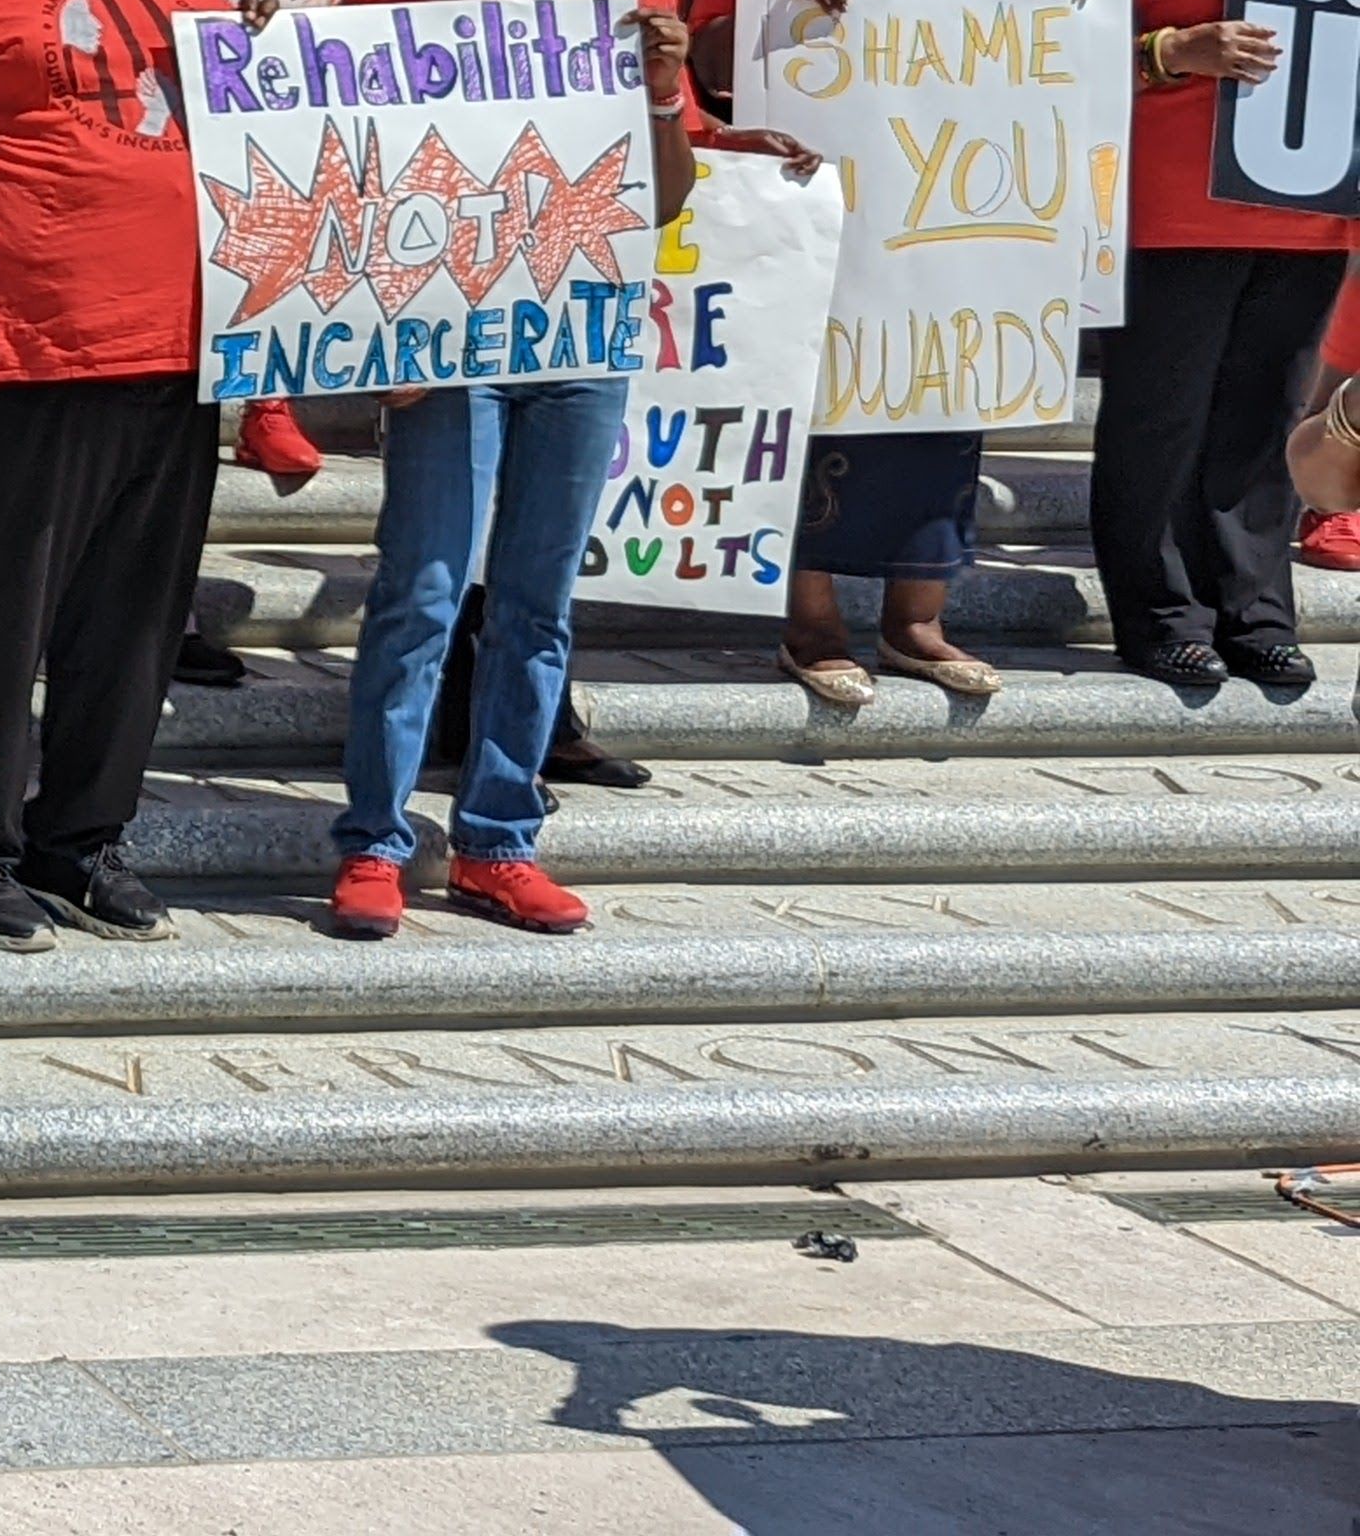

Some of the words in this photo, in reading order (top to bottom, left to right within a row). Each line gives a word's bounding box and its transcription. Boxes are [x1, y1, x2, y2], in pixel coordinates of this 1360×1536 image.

[782, 0, 1075, 100] SHAME
[887, 104, 1068, 230] YOU
[211, 279, 646, 400] INCARCERATE
[822, 297, 1069, 426] DWARDS
[606, 476, 733, 533] NOT
[15, 1028, 1172, 1096] VERMONT
